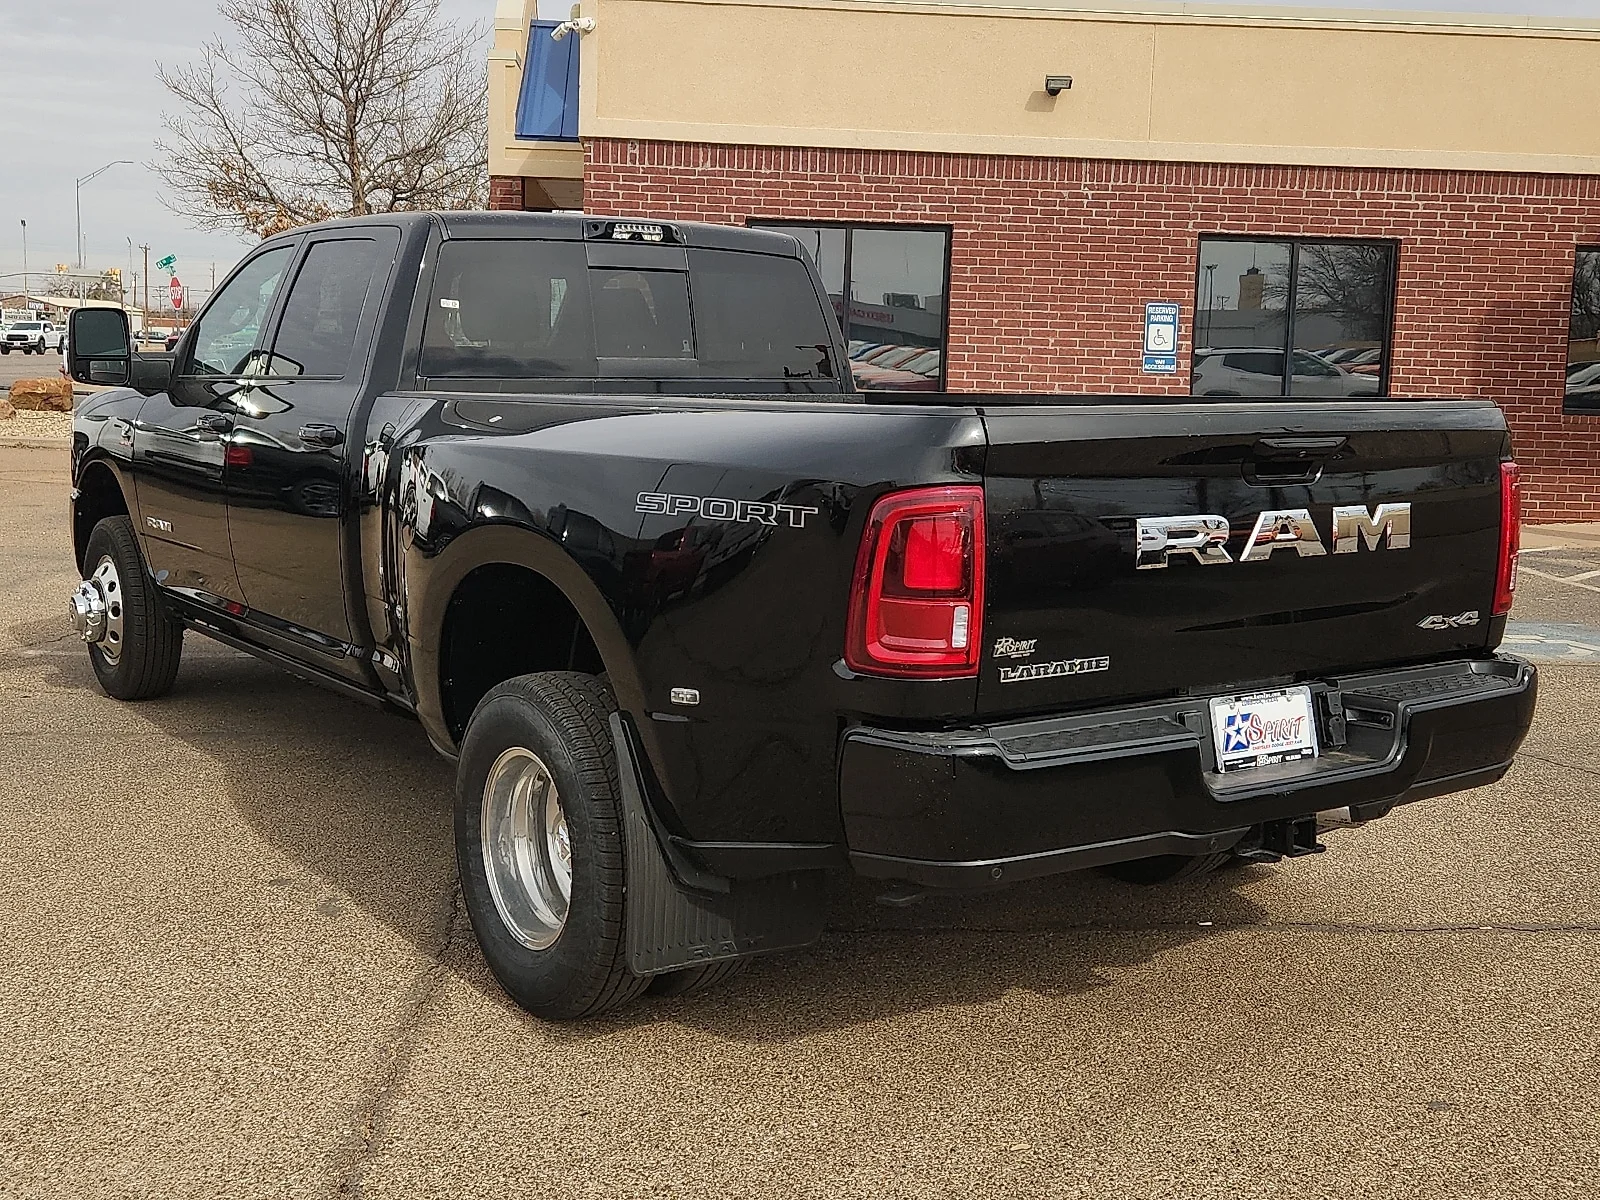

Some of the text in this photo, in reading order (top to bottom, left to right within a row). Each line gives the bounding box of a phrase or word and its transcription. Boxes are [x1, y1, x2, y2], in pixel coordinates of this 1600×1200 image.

[171, 287, 181, 300] STOP
[1148, 306, 1176, 314] RESERVED
[634, 491, 819, 528] SPORT
[1136, 502, 1412, 570] RAM
[998, 656, 1110, 682] LARAMIE
